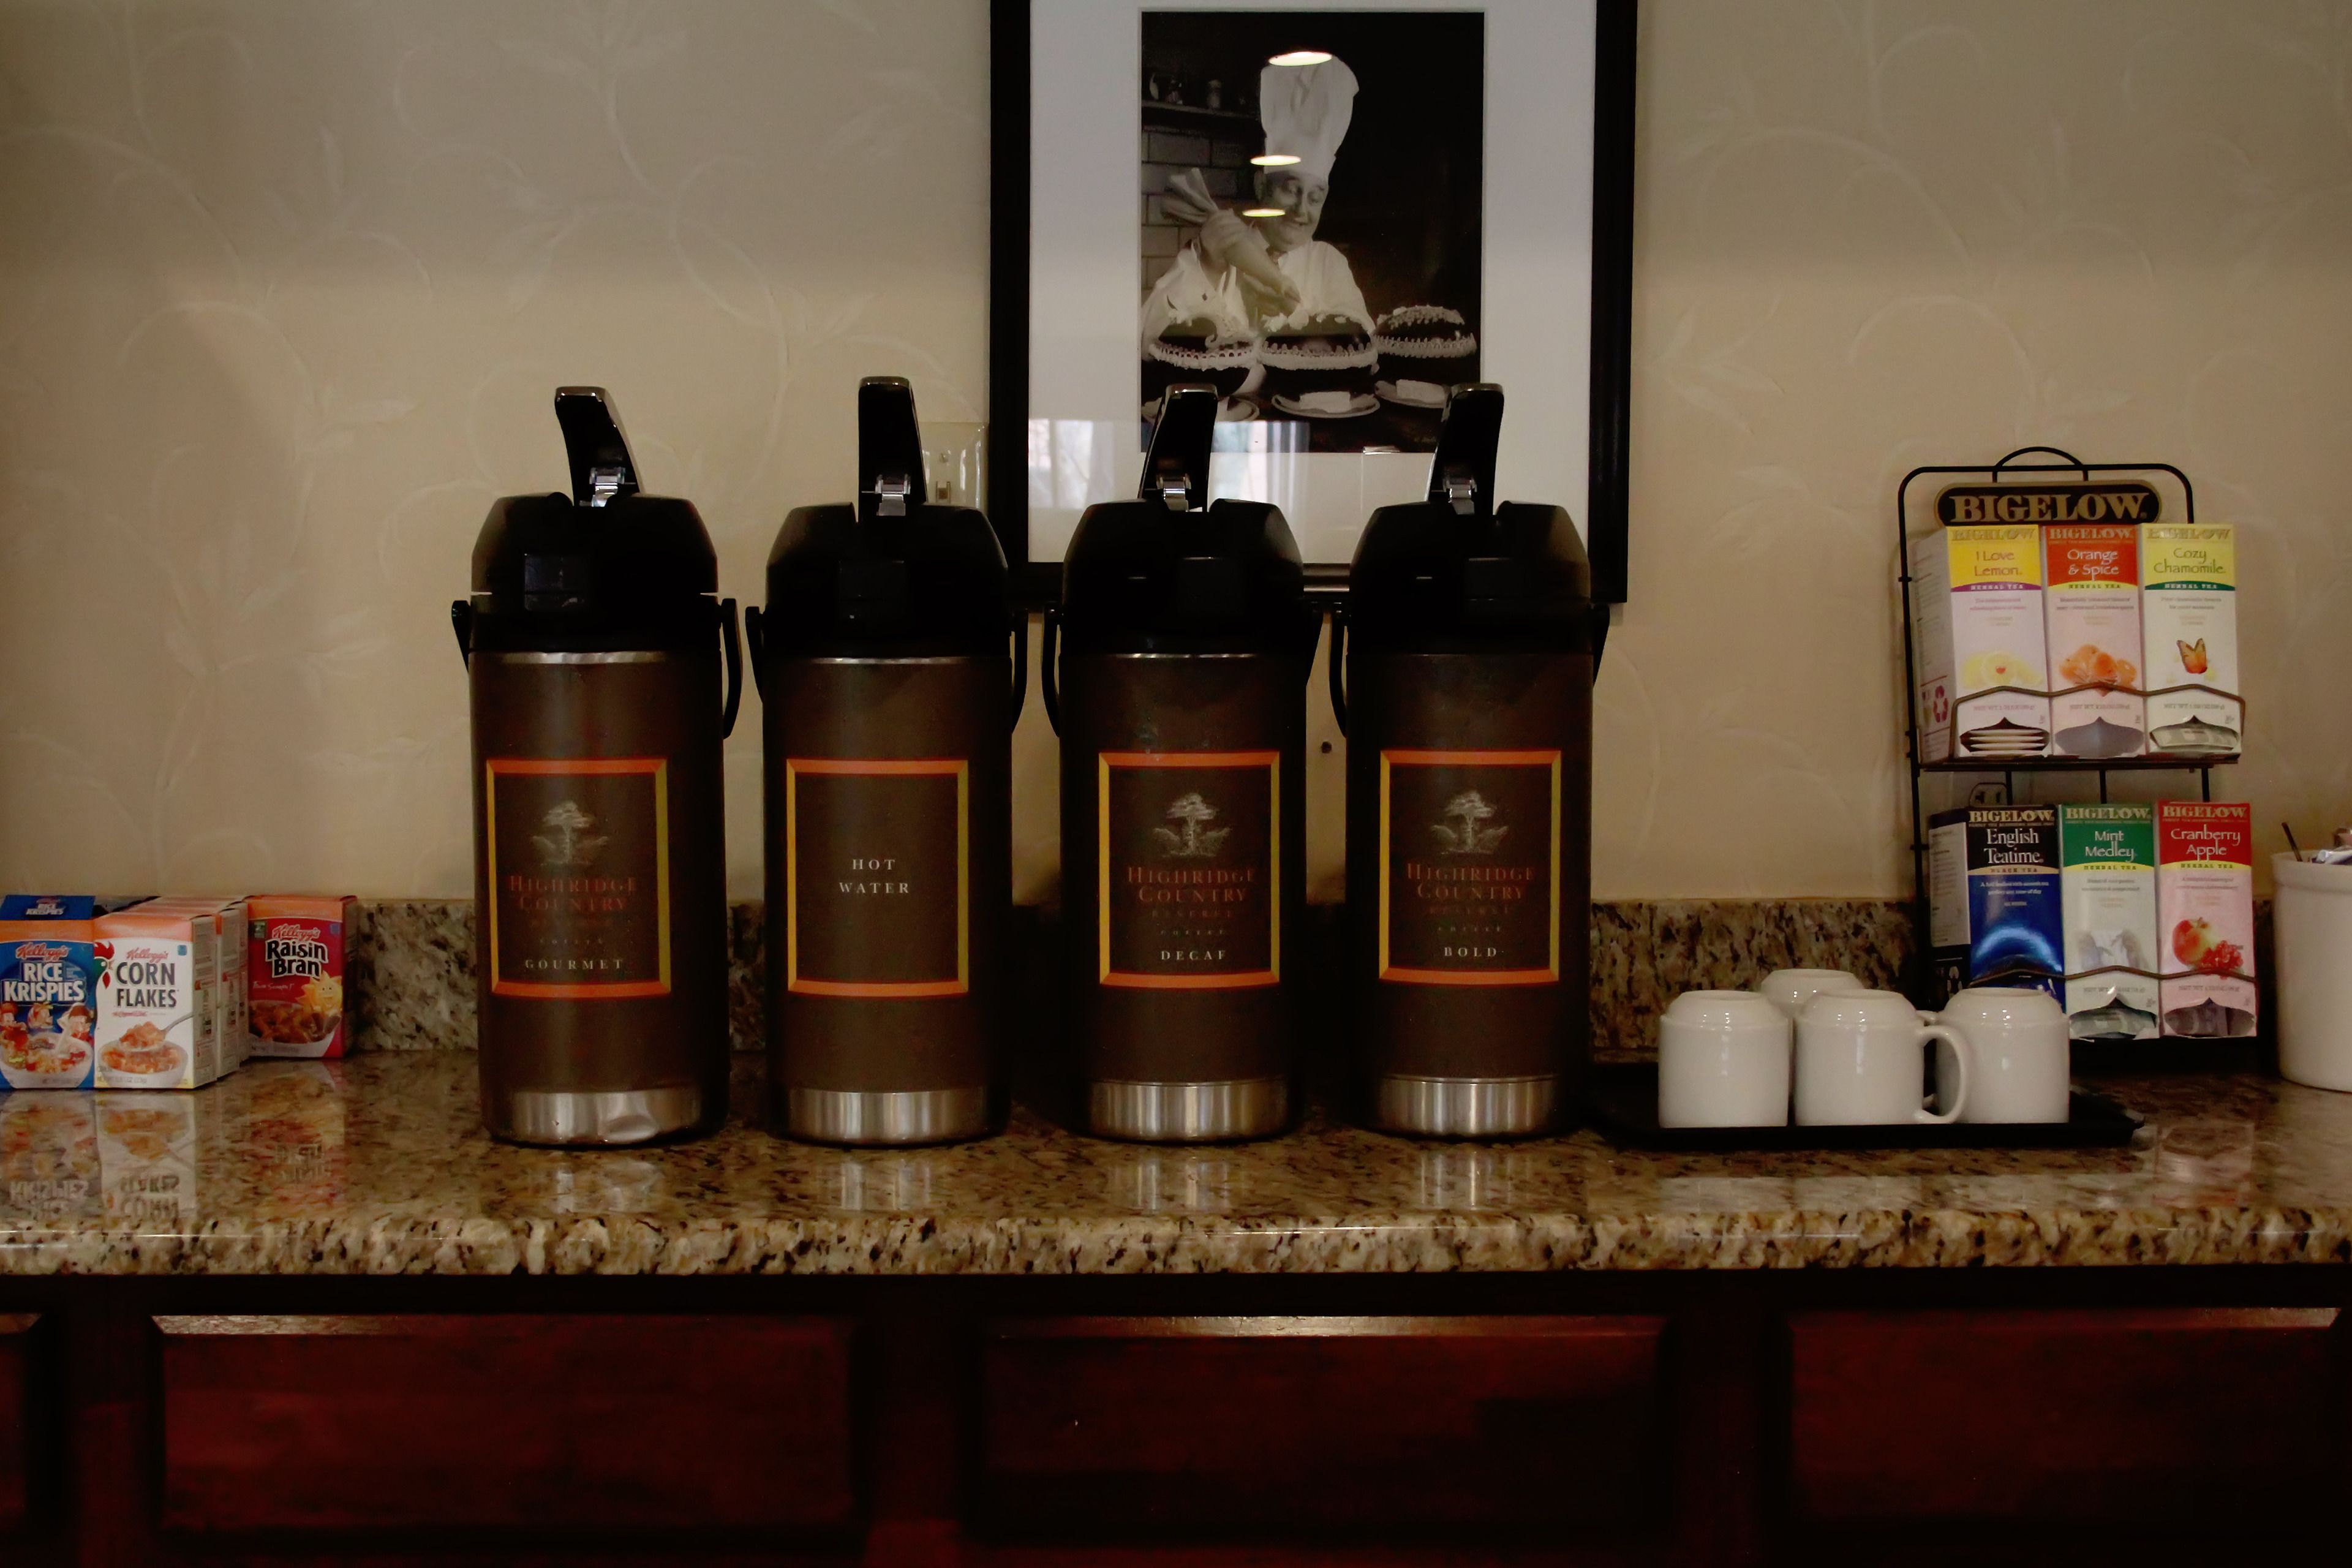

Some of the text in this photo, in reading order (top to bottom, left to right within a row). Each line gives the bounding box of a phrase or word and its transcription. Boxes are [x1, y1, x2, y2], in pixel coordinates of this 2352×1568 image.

[1976, 551, 2015, 561] I Love
[2067, 549, 2119, 565] Orange
[2173, 548, 2207, 564] Cozy
[2068, 564, 2119, 581] & Spice
[2163, 806, 2247, 818] BIGELOW
[1986, 828, 2039, 847] English
[2095, 830, 2124, 841] Mint
[2171, 824, 2241, 846] Cranberry
[1983, 847, 2040, 864] Teatime
[2085, 841, 2135, 863] Medley
[2185, 839, 2227, 861] Apple
[851, 859, 895, 871] HOT
[1408, 863, 1534, 881] HIGHRIDGE
[1128, 867, 1257, 884] HIGHRIDGE
[839, 881, 910, 894] WATER
[1139, 886, 1247, 903] COUNTRY
[1417, 882, 1523, 900] COUNTRY
[273, 924, 320, 941] Kellogg's
[17, 943, 69, 962] Kellogg's
[127, 948, 169, 963] Kellogg's
[266, 940, 327, 962] Raisin
[1161, 950, 1225, 961] DECAF
[1444, 946, 1497, 957] BOLD
[23, 963, 63, 981] RICE
[273, 959, 321, 978] Bran
[524, 959, 624, 970] GOURMET
[116, 962, 175, 985] CORN
[4, 981, 85, 1001] KRISPIES
[117, 988, 178, 1008] FLAKES
